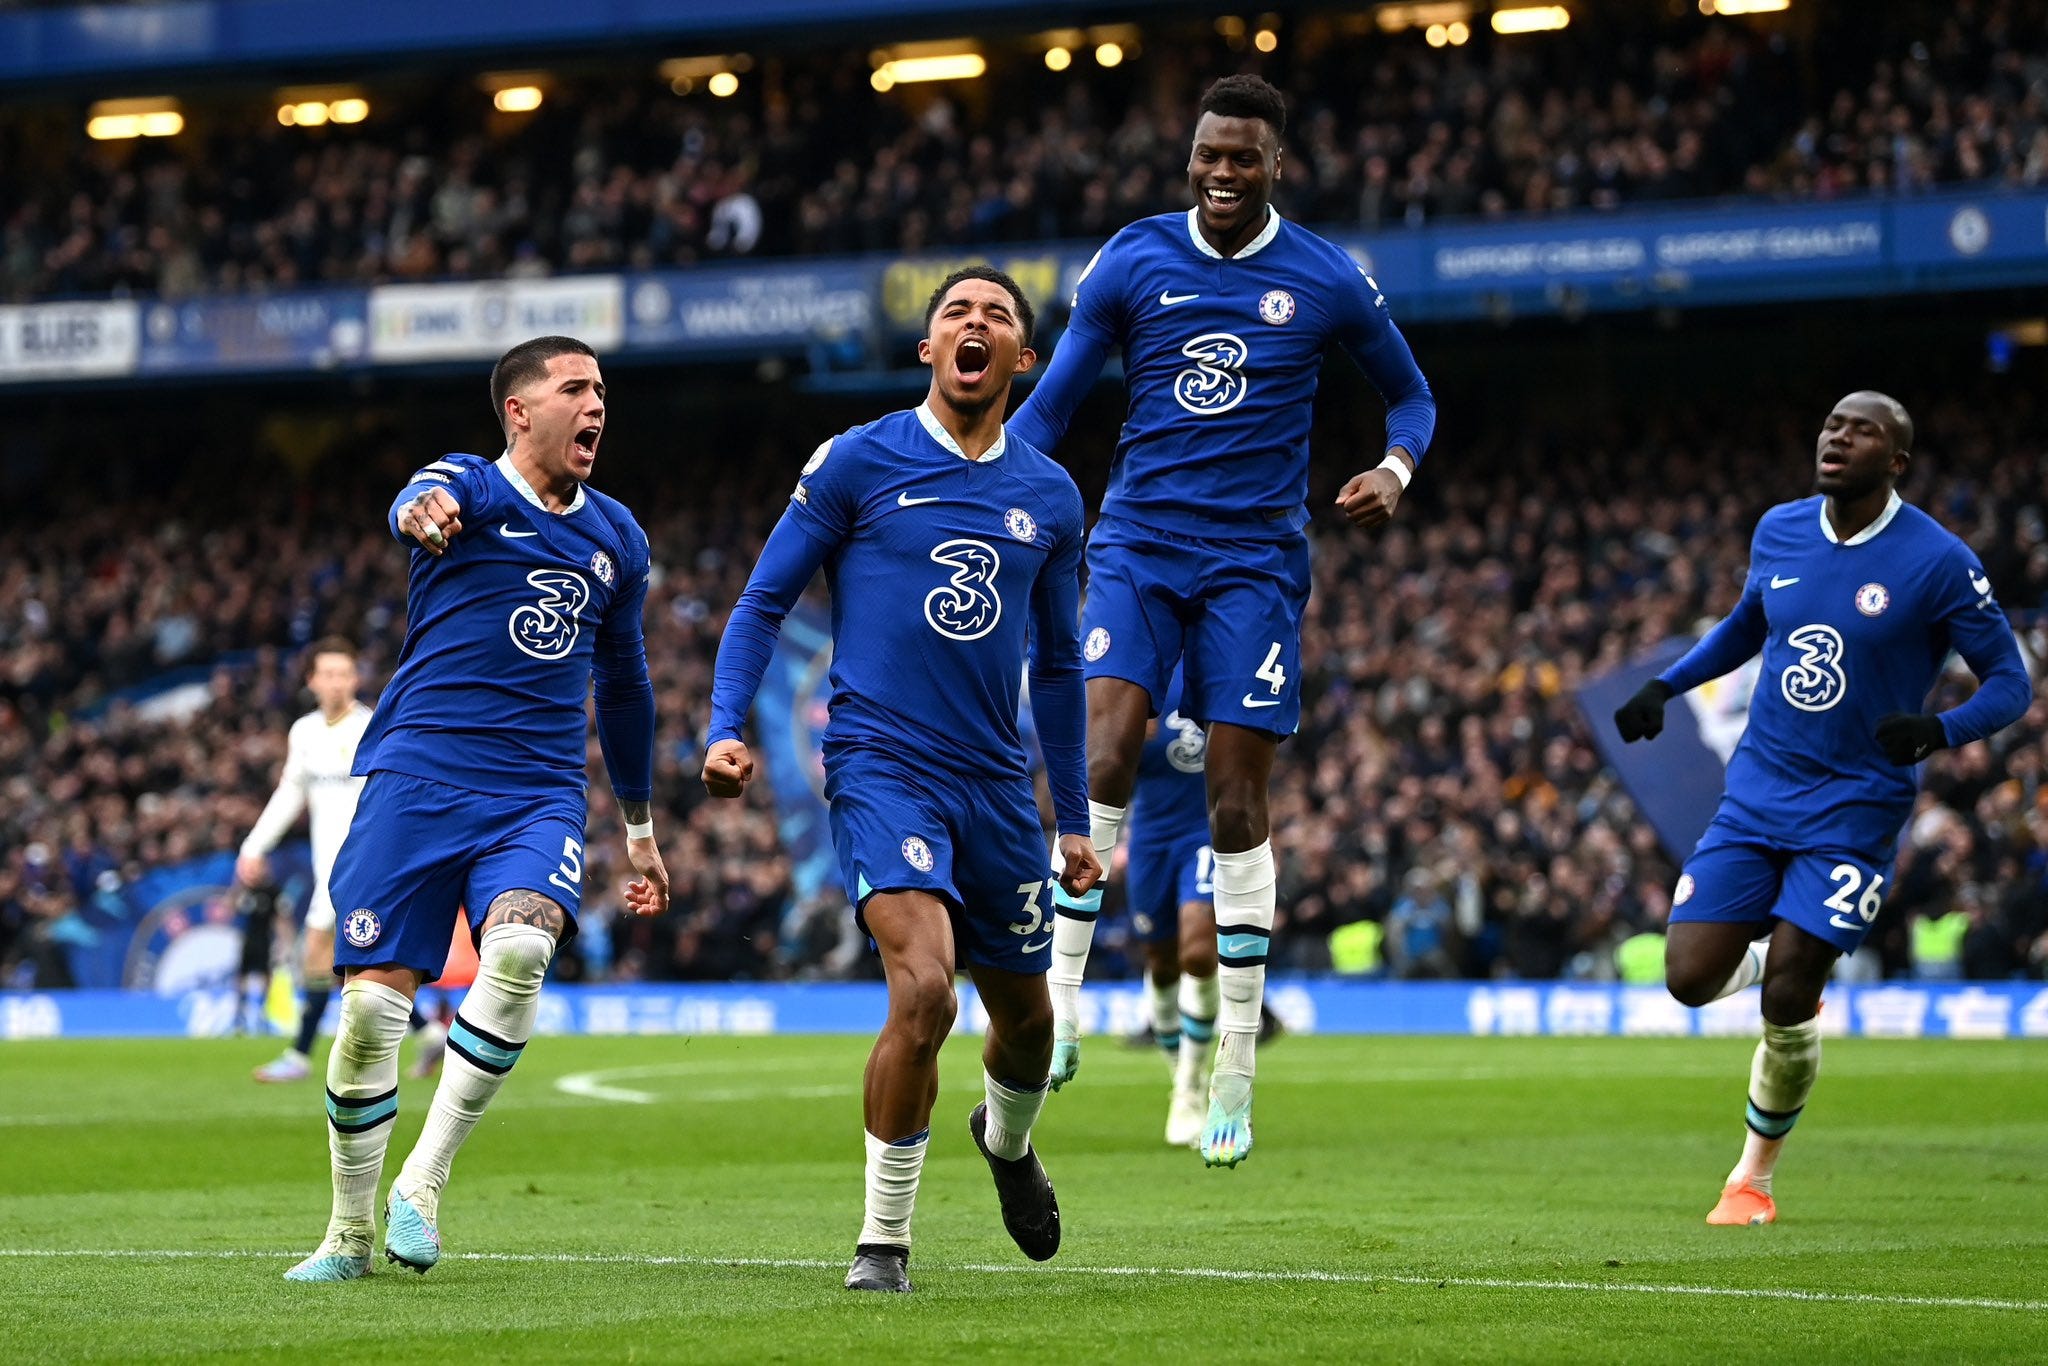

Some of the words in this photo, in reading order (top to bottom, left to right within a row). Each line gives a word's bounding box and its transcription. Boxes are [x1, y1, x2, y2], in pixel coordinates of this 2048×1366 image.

[1174, 333, 1248, 415] 3
[508, 568, 590, 660] 3
[924, 538, 1001, 641] 3
[1255, 641, 1286, 695] 4
[1781, 623, 1847, 712] 3
[559, 835, 582, 884] 5
[1823, 863, 1884, 923] 26
